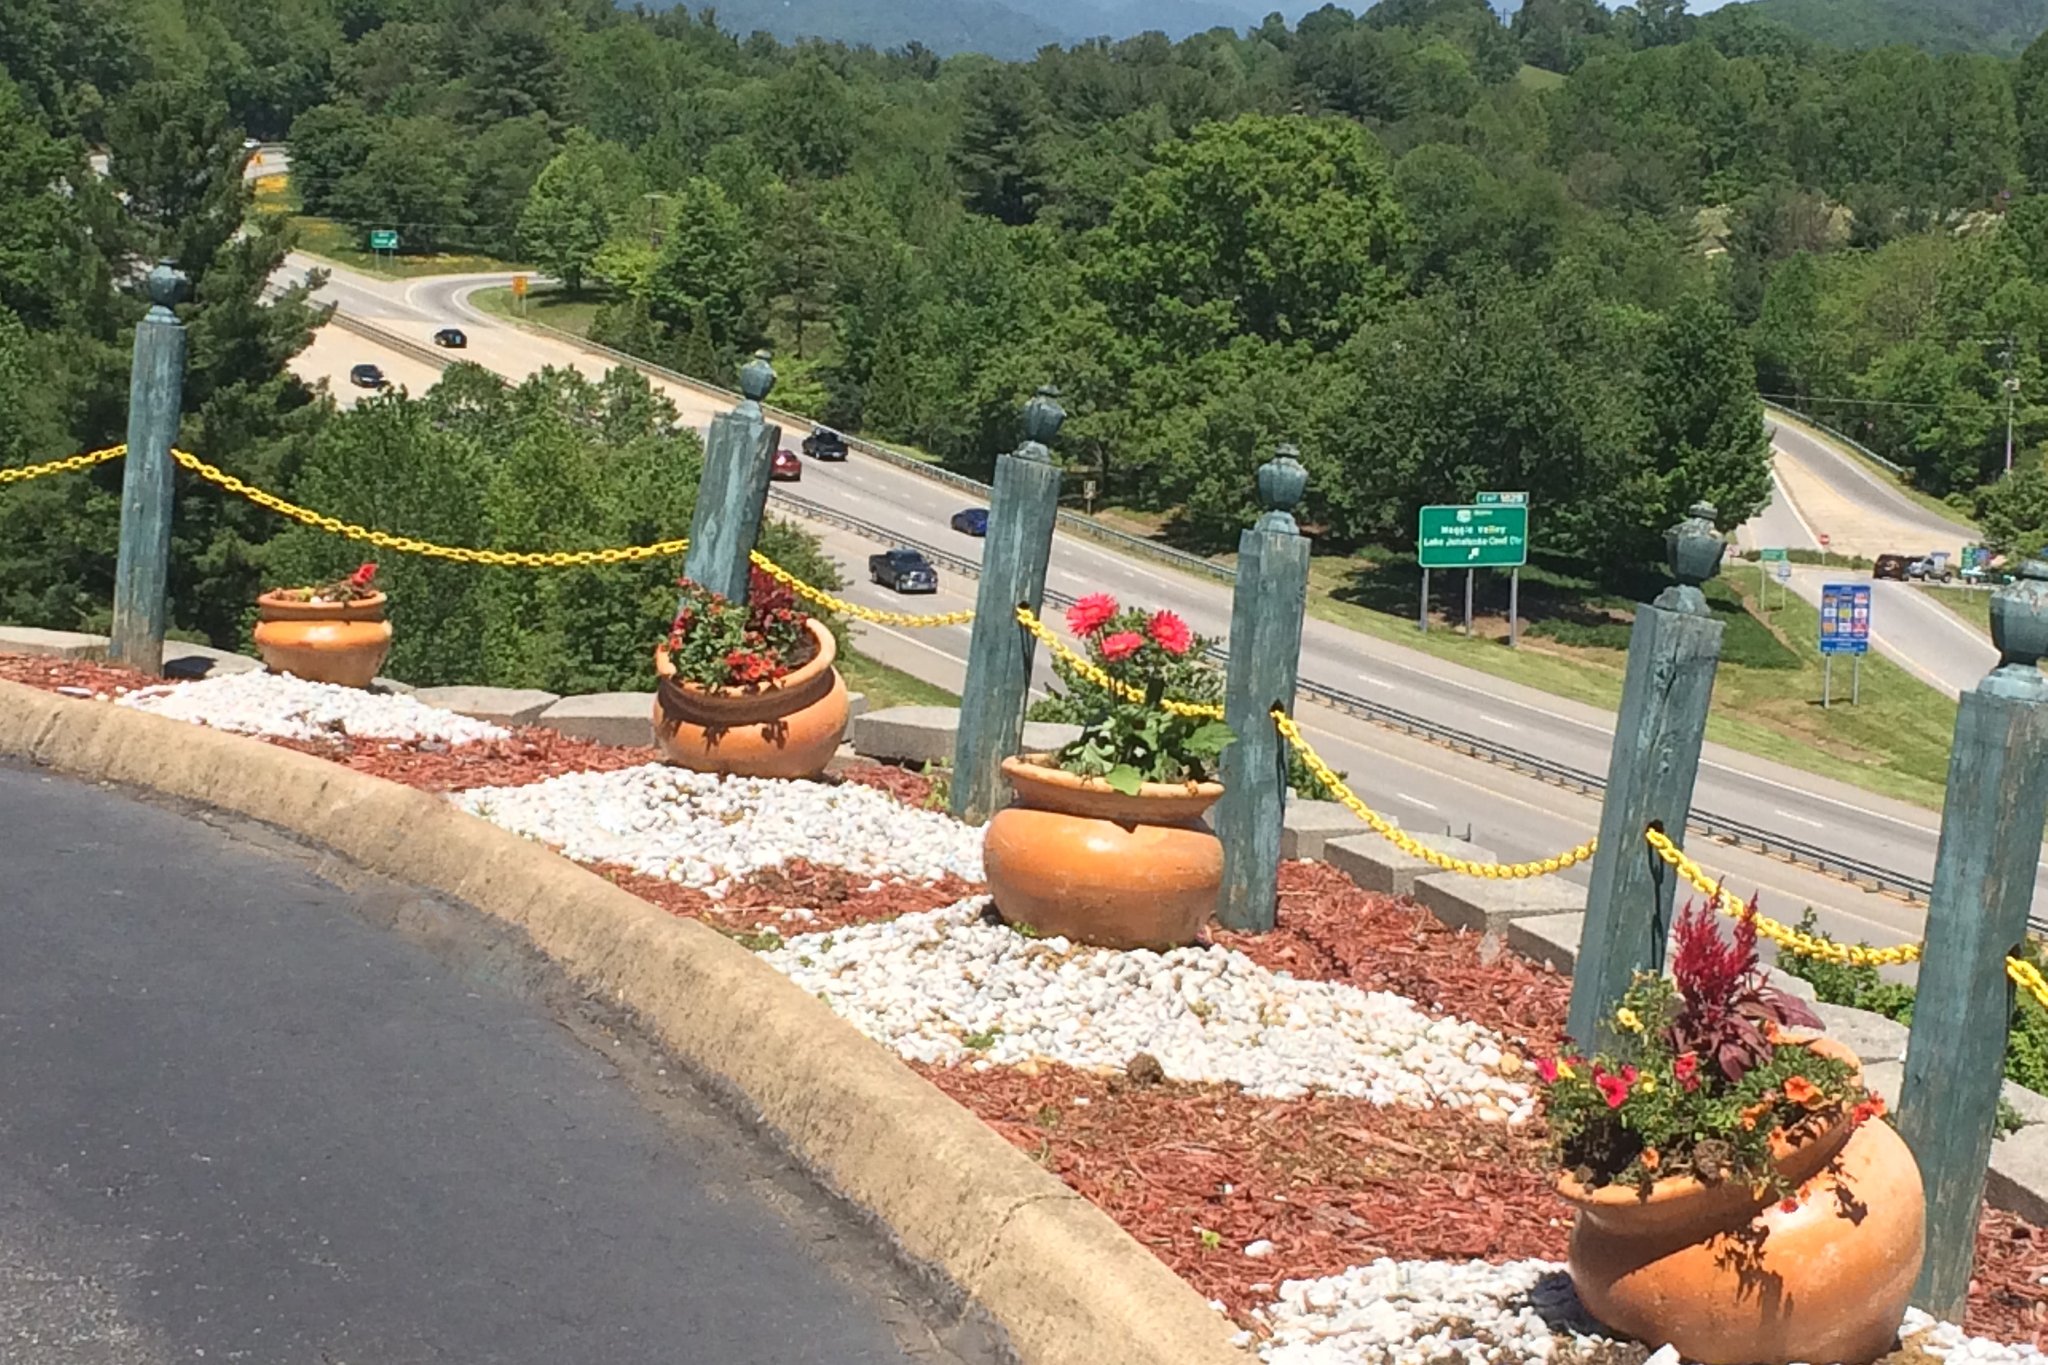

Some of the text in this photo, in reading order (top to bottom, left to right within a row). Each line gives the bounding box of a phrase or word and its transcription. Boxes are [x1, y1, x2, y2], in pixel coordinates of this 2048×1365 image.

[1440, 525, 1507, 536] Maggie Valley
[1423, 537, 1444, 547] Lake
